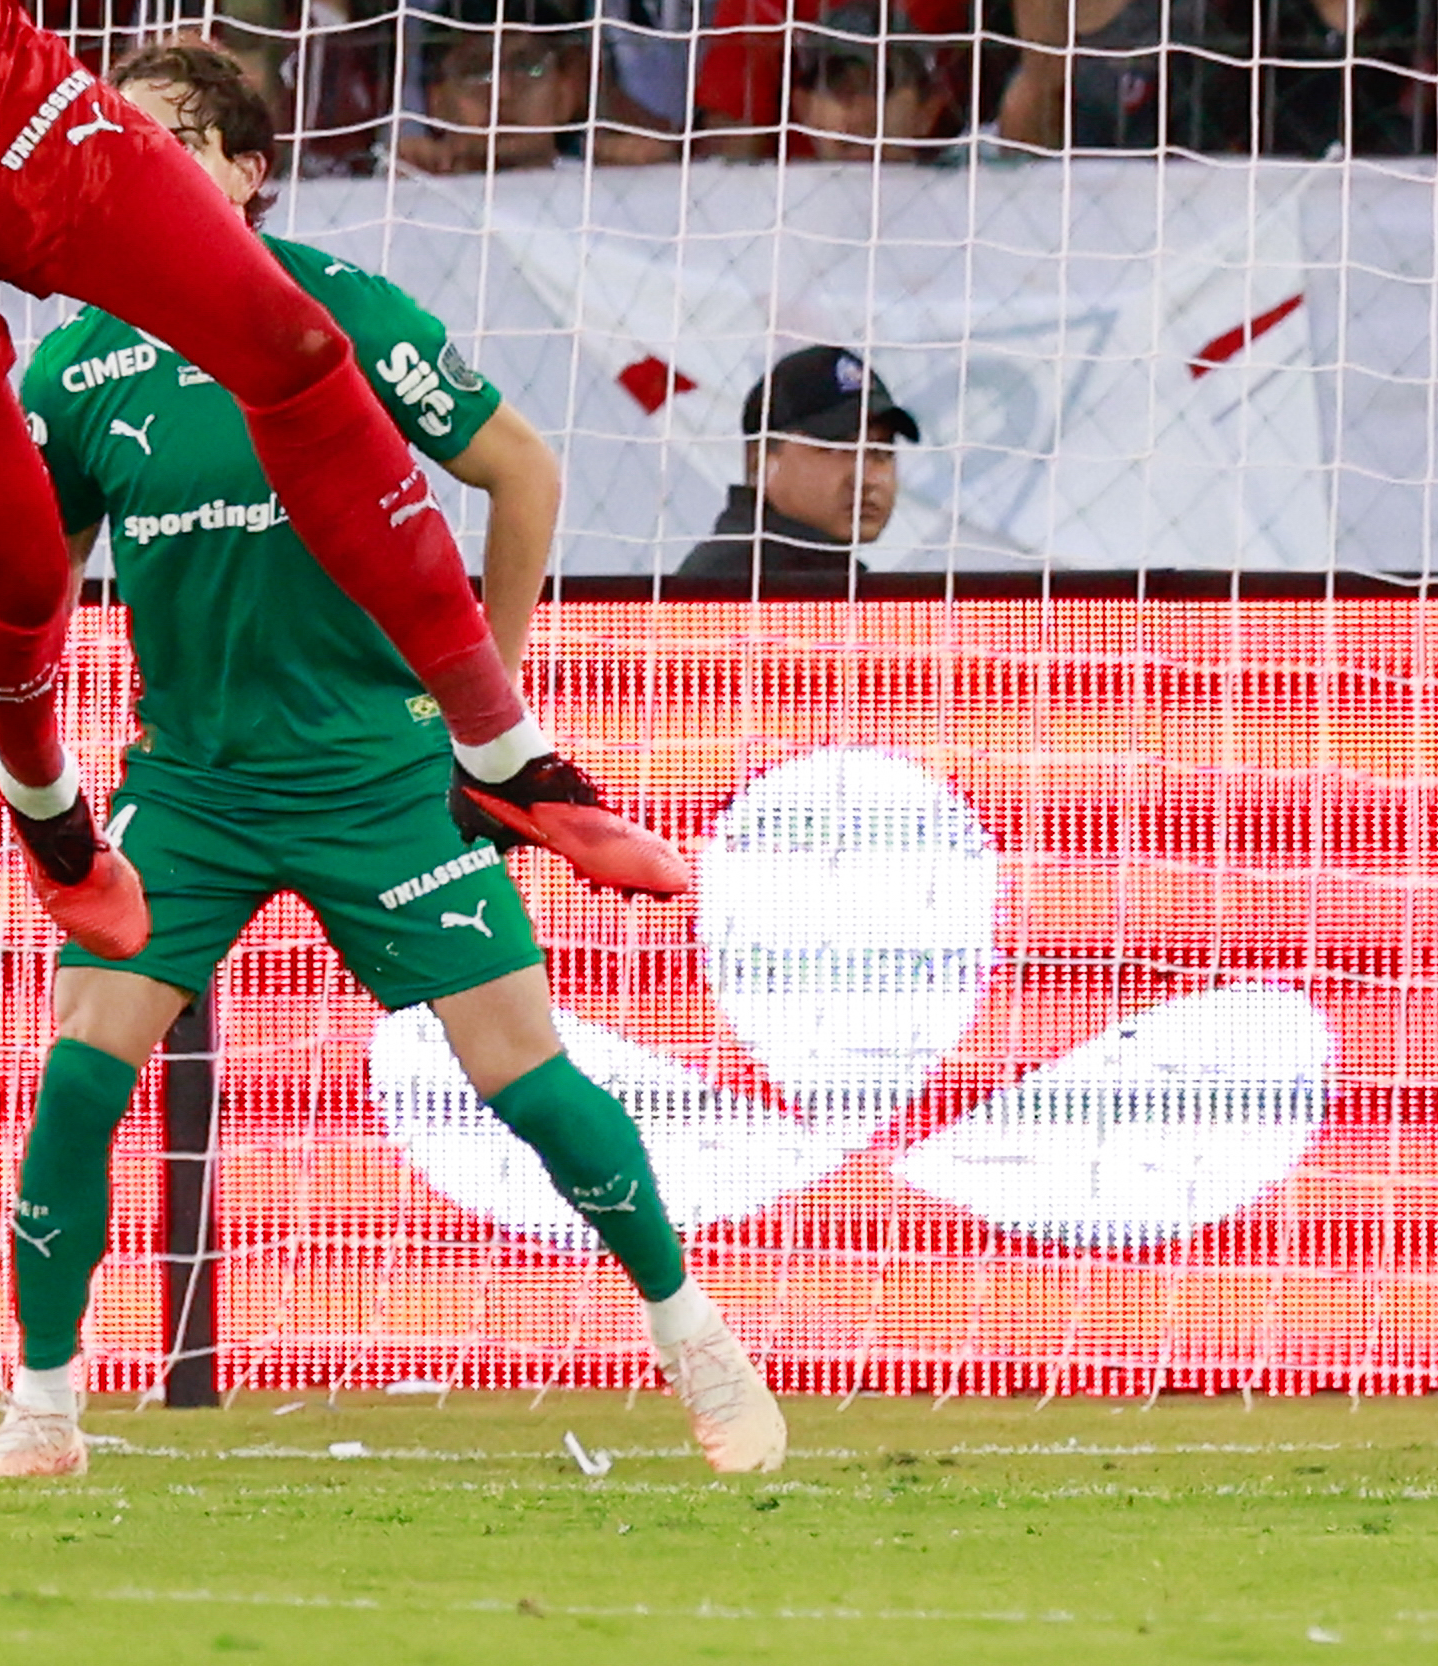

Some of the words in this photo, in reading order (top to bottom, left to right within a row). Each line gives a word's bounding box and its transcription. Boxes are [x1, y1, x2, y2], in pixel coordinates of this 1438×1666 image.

[62, 343, 158, 393] CIMED
[124, 493, 289, 545] sporting
[378, 844, 501, 910] UNIASSELVI
